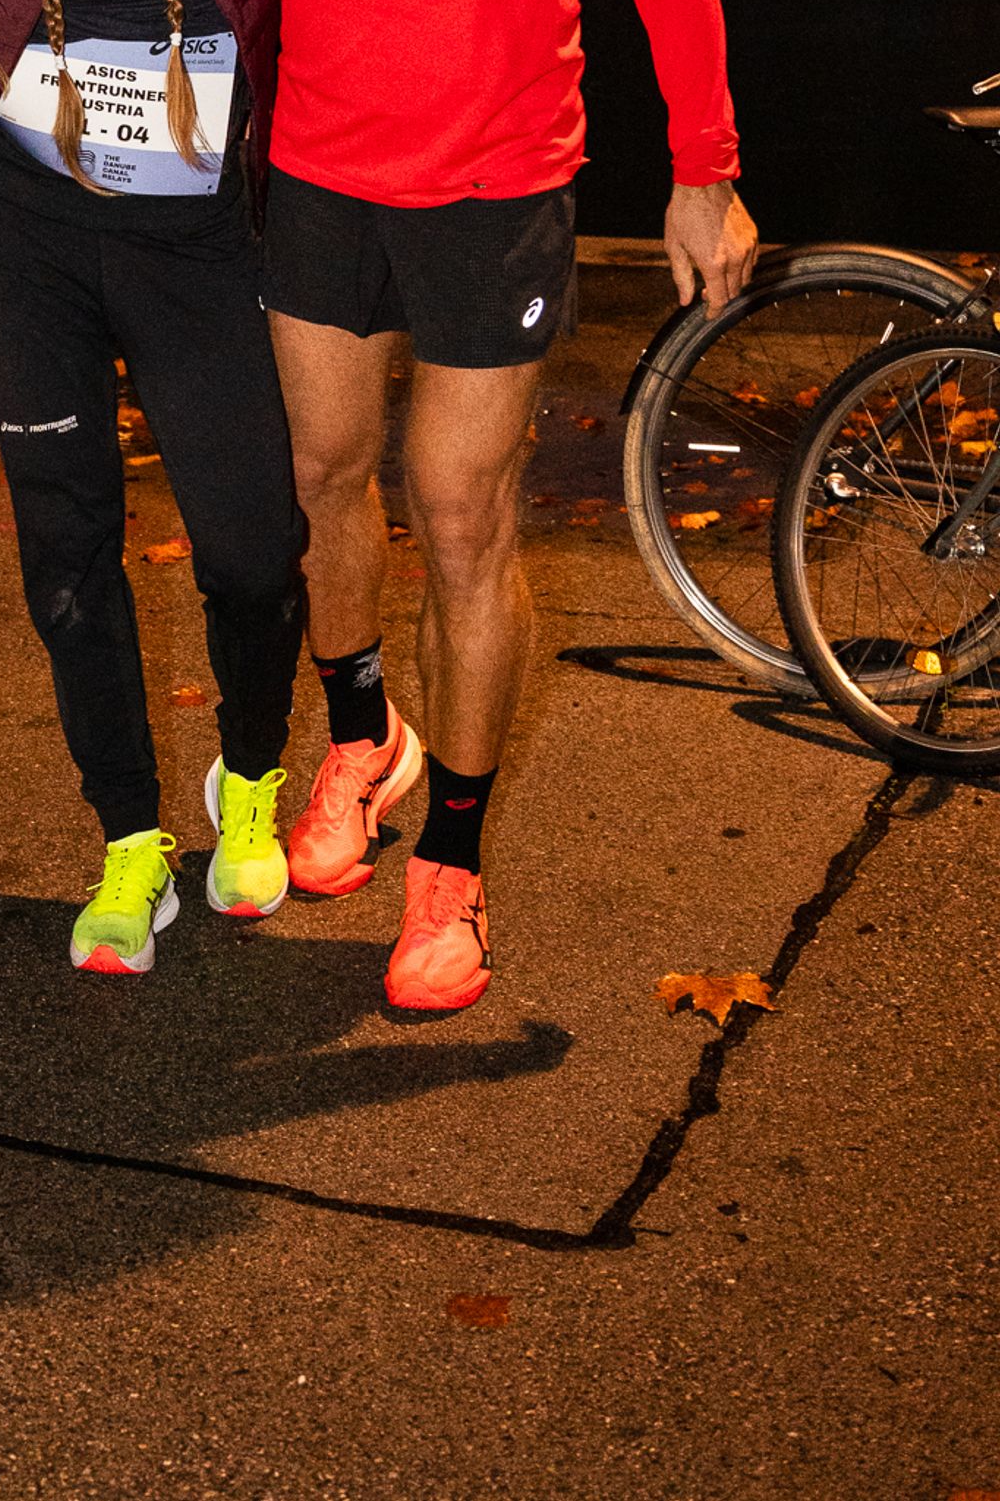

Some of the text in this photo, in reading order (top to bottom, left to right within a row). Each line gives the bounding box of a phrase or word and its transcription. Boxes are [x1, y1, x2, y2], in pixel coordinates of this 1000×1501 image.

[182, 39, 218, 55] SICS
[86, 64, 137, 82] ASICS
[40, 73, 167, 103] FRNTRUNNER
[82, 98, 144, 118] USTRIA
[117, 124, 149, 144] 04
[103, 161, 136, 171] DANUBE
[104, 154, 120, 162] THE
[102, 168, 129, 176] CANAL
[102, 174, 132, 183] RELAYS
